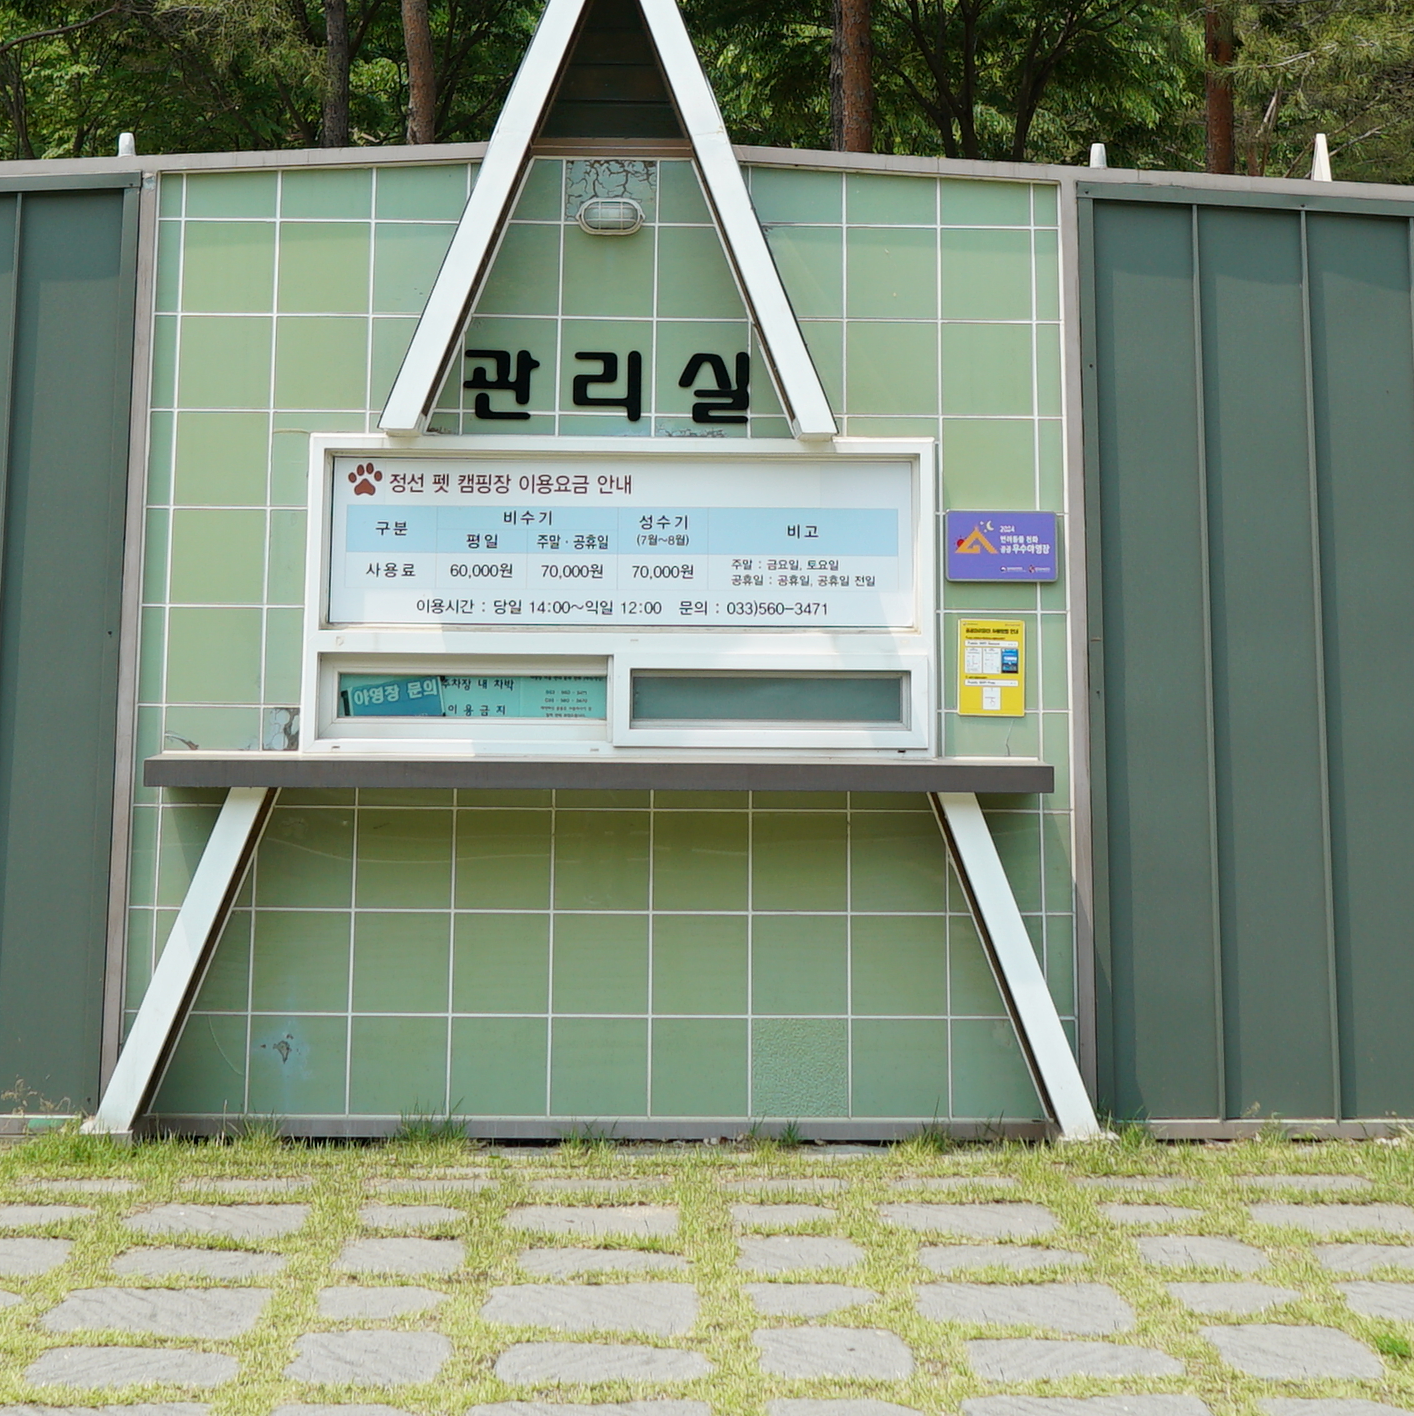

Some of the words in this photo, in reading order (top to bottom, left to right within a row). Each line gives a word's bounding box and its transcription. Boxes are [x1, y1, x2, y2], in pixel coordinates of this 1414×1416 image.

[463, 349, 751, 424] 관리실
[389, 472, 424, 494] 정선
[432, 473, 450, 493] 펫
[457, 473, 512, 495] 캠핑장
[518, 473, 590, 495] 이용요금
[597, 474, 632, 495] 안내
[503, 510, 552, 526] 비수기
[639, 514, 688, 530] 성수기
[375, 521, 408, 536] 구분
[787, 524, 819, 539] 비고
[466, 533, 498, 549] 평일
[536, 534, 561, 550] 주말
[573, 534, 609, 550] 공휴일
[365, 562, 416, 578] 사용료
[450, 562, 513, 579] 60,000원
[541, 563, 604, 579] 70,000원
[632, 564, 694, 580] 70,000원
[731, 558, 753, 571] 주말
[806, 559, 839, 572] 토요일
[731, 574, 764, 587] 공휴일
[817, 574, 850, 587] 공휴일
[416, 598, 474, 615] 이용시간
[493, 599, 522, 615] 당일
[621, 601, 663, 615] 12:00
[678, 600, 708, 616] 문의
[726, 600, 827, 617] 033)560-3471
[354, 684, 400, 706] 야영장
[407, 678, 438, 699] 문의
